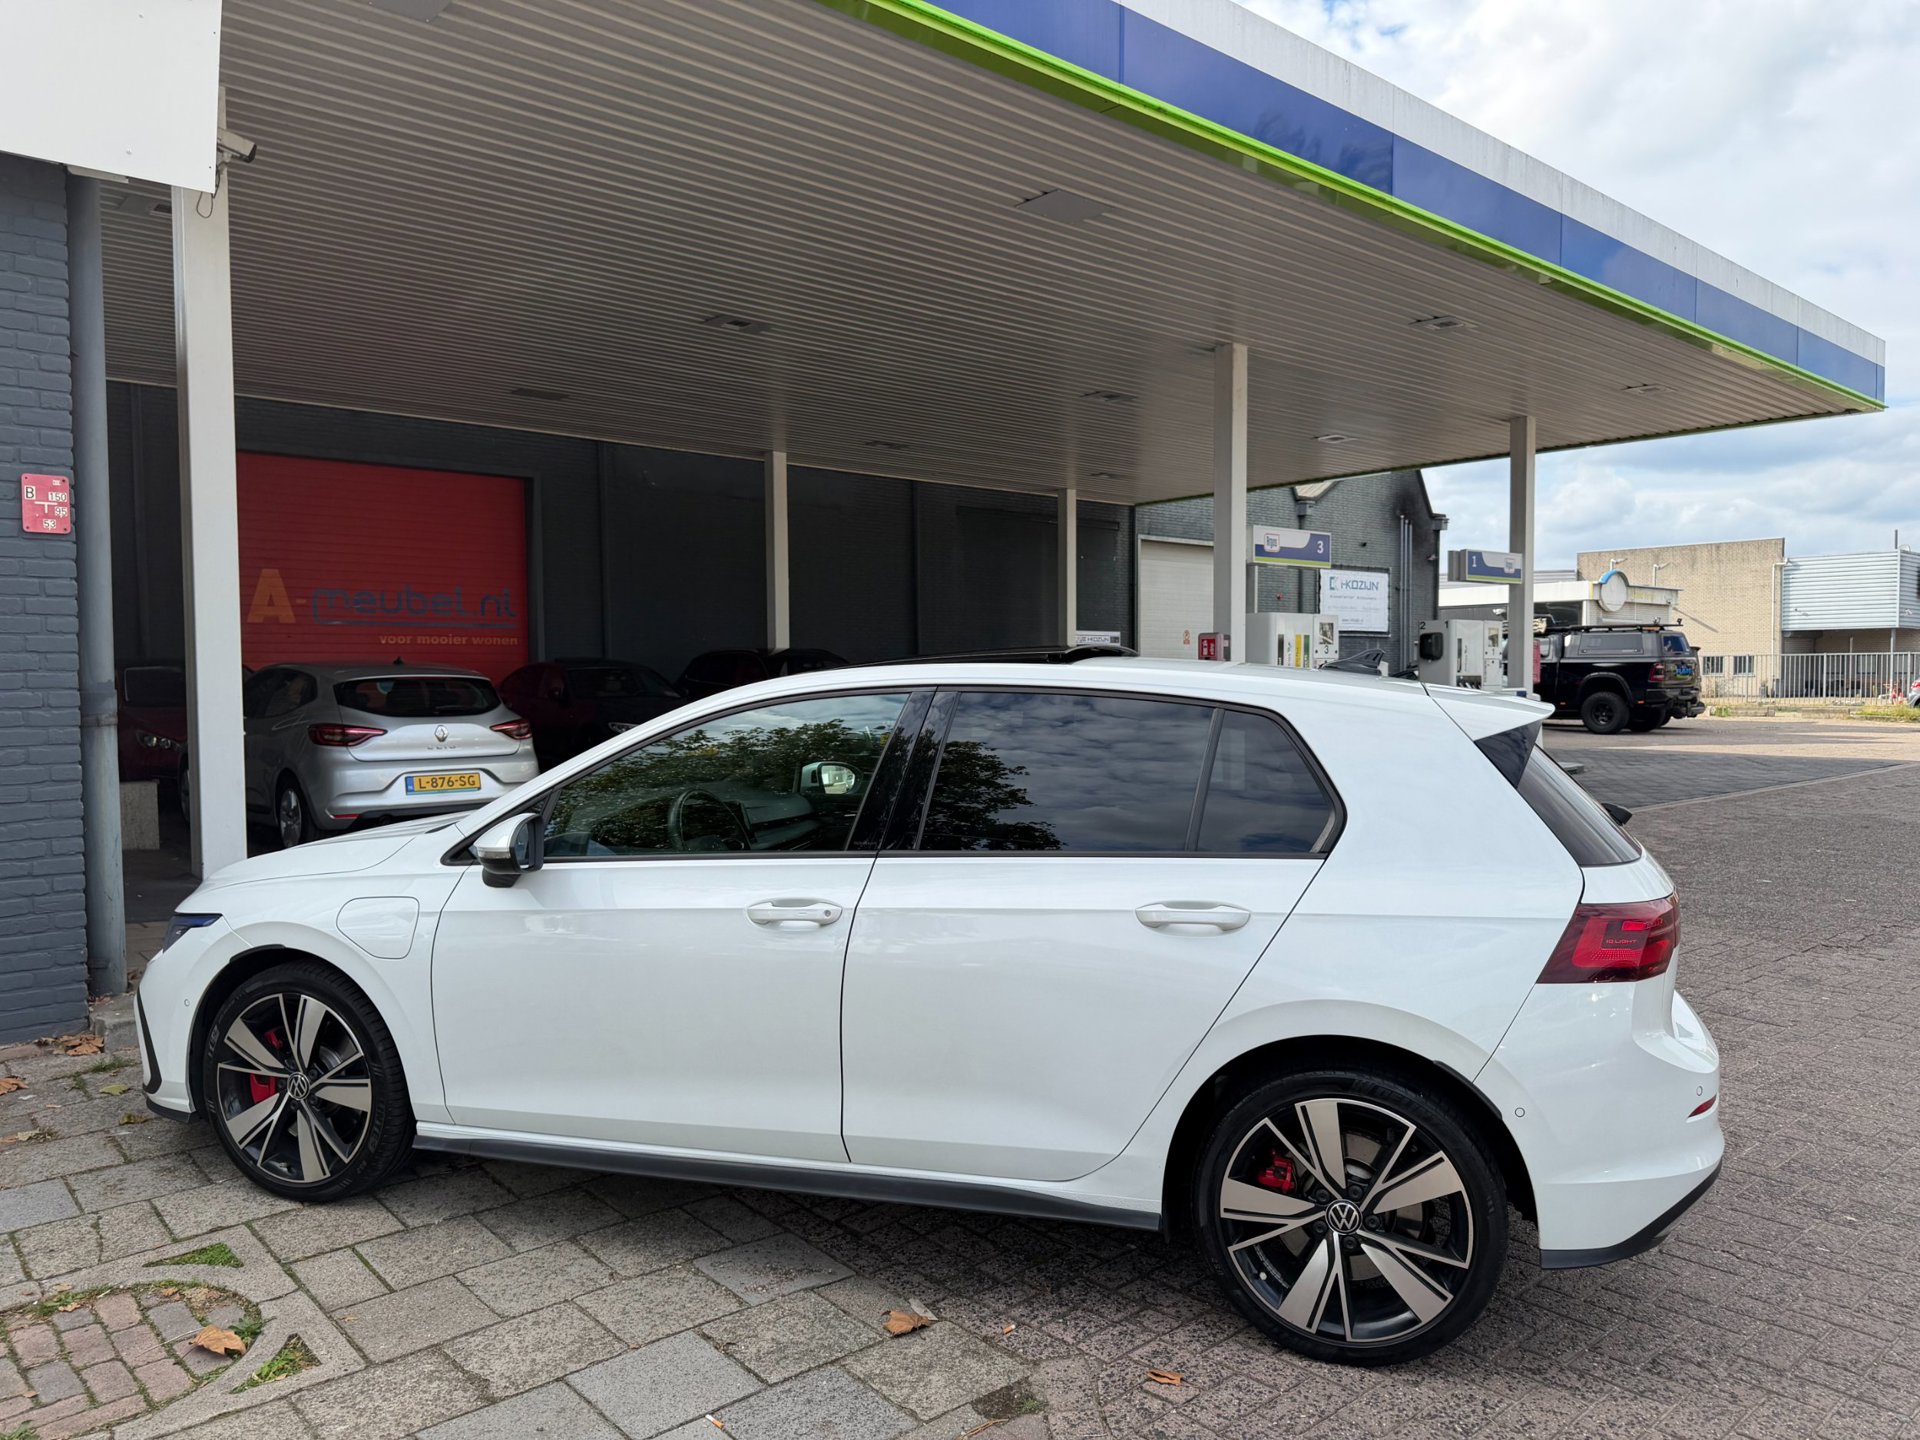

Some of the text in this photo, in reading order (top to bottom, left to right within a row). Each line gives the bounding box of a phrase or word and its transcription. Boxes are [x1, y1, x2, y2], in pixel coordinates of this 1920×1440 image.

[25, 486, 35, 499] B
[49, 492, 67, 502] 150
[1316, 540, 1325, 554] 3
[1471, 555, 1477, 568] 1
[1419, 621, 1426, 630] 2
[1444, 620, 1449, 629] 1
[379, 633, 518, 646] voor mooier wonen
[1323, 644, 1329, 655] 3
[418, 775, 476, 789] L-876-SG
